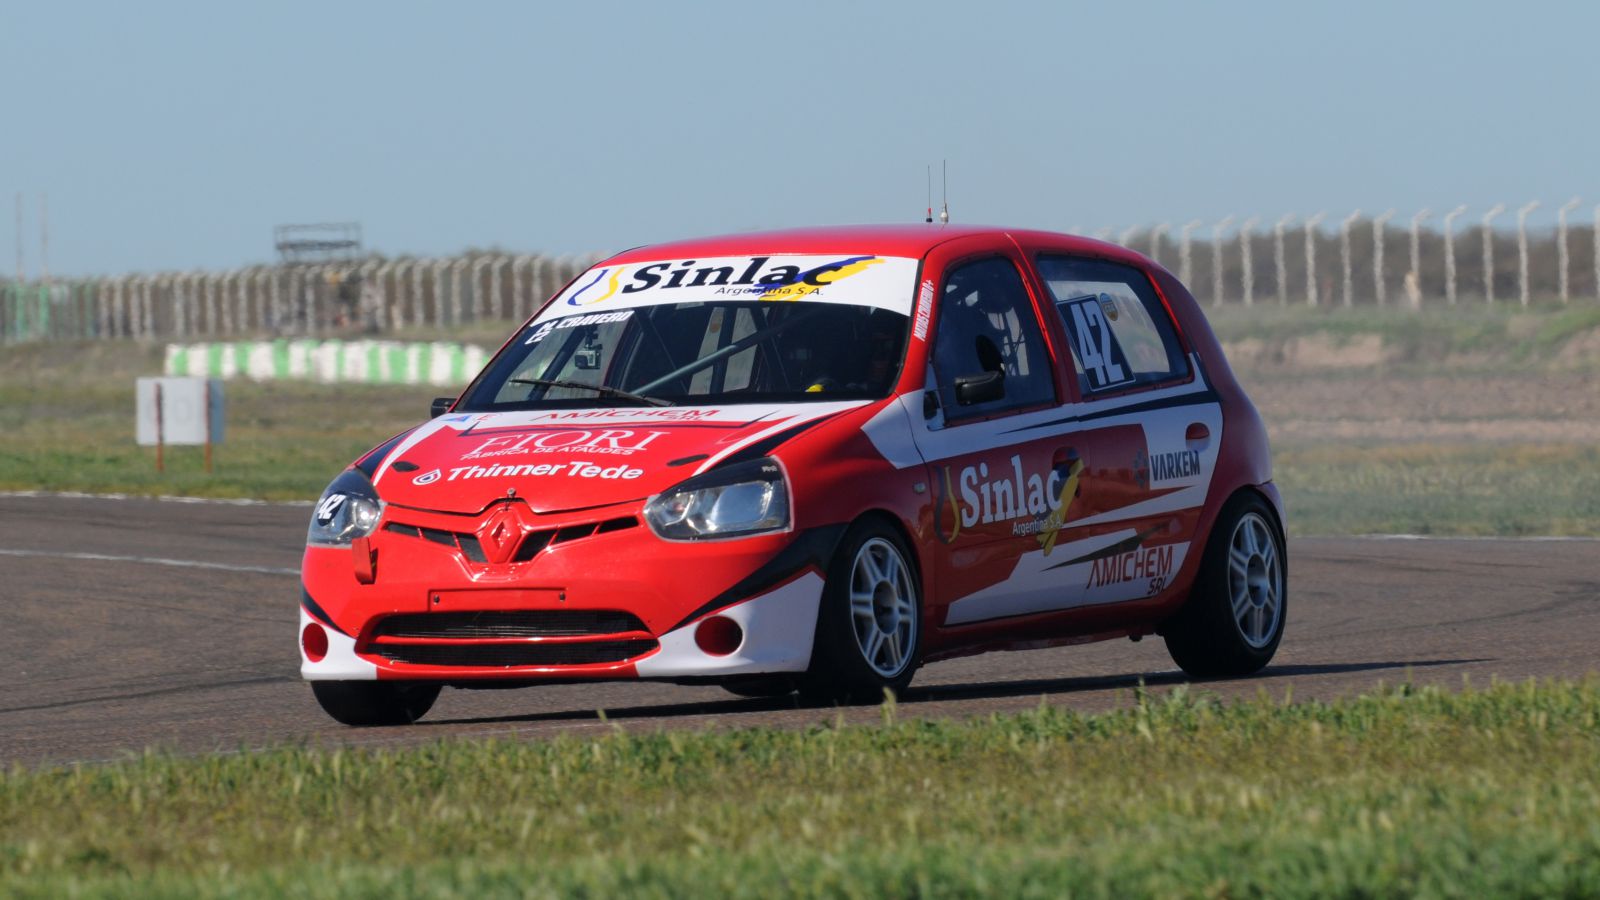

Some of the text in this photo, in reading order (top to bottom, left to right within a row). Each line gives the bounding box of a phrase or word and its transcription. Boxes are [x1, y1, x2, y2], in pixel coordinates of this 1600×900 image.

[622, 257, 842, 293] Sinlac
[715, 286, 824, 297] Argentina S.A.
[555, 311, 635, 329] CRAVERO
[1070, 300, 1125, 385] 42
[529, 409, 720, 422] AMICHEM
[460, 446, 634, 460] FABRICA DE ATAUDES
[471, 430, 671, 455] FIORI
[447, 461, 644, 482] Thinner Tede
[1150, 450, 1201, 481] VARKEM
[959, 455, 1062, 528] Sinlac
[317, 493, 347, 520] 42
[1086, 545, 1173, 590] AMICHEM
